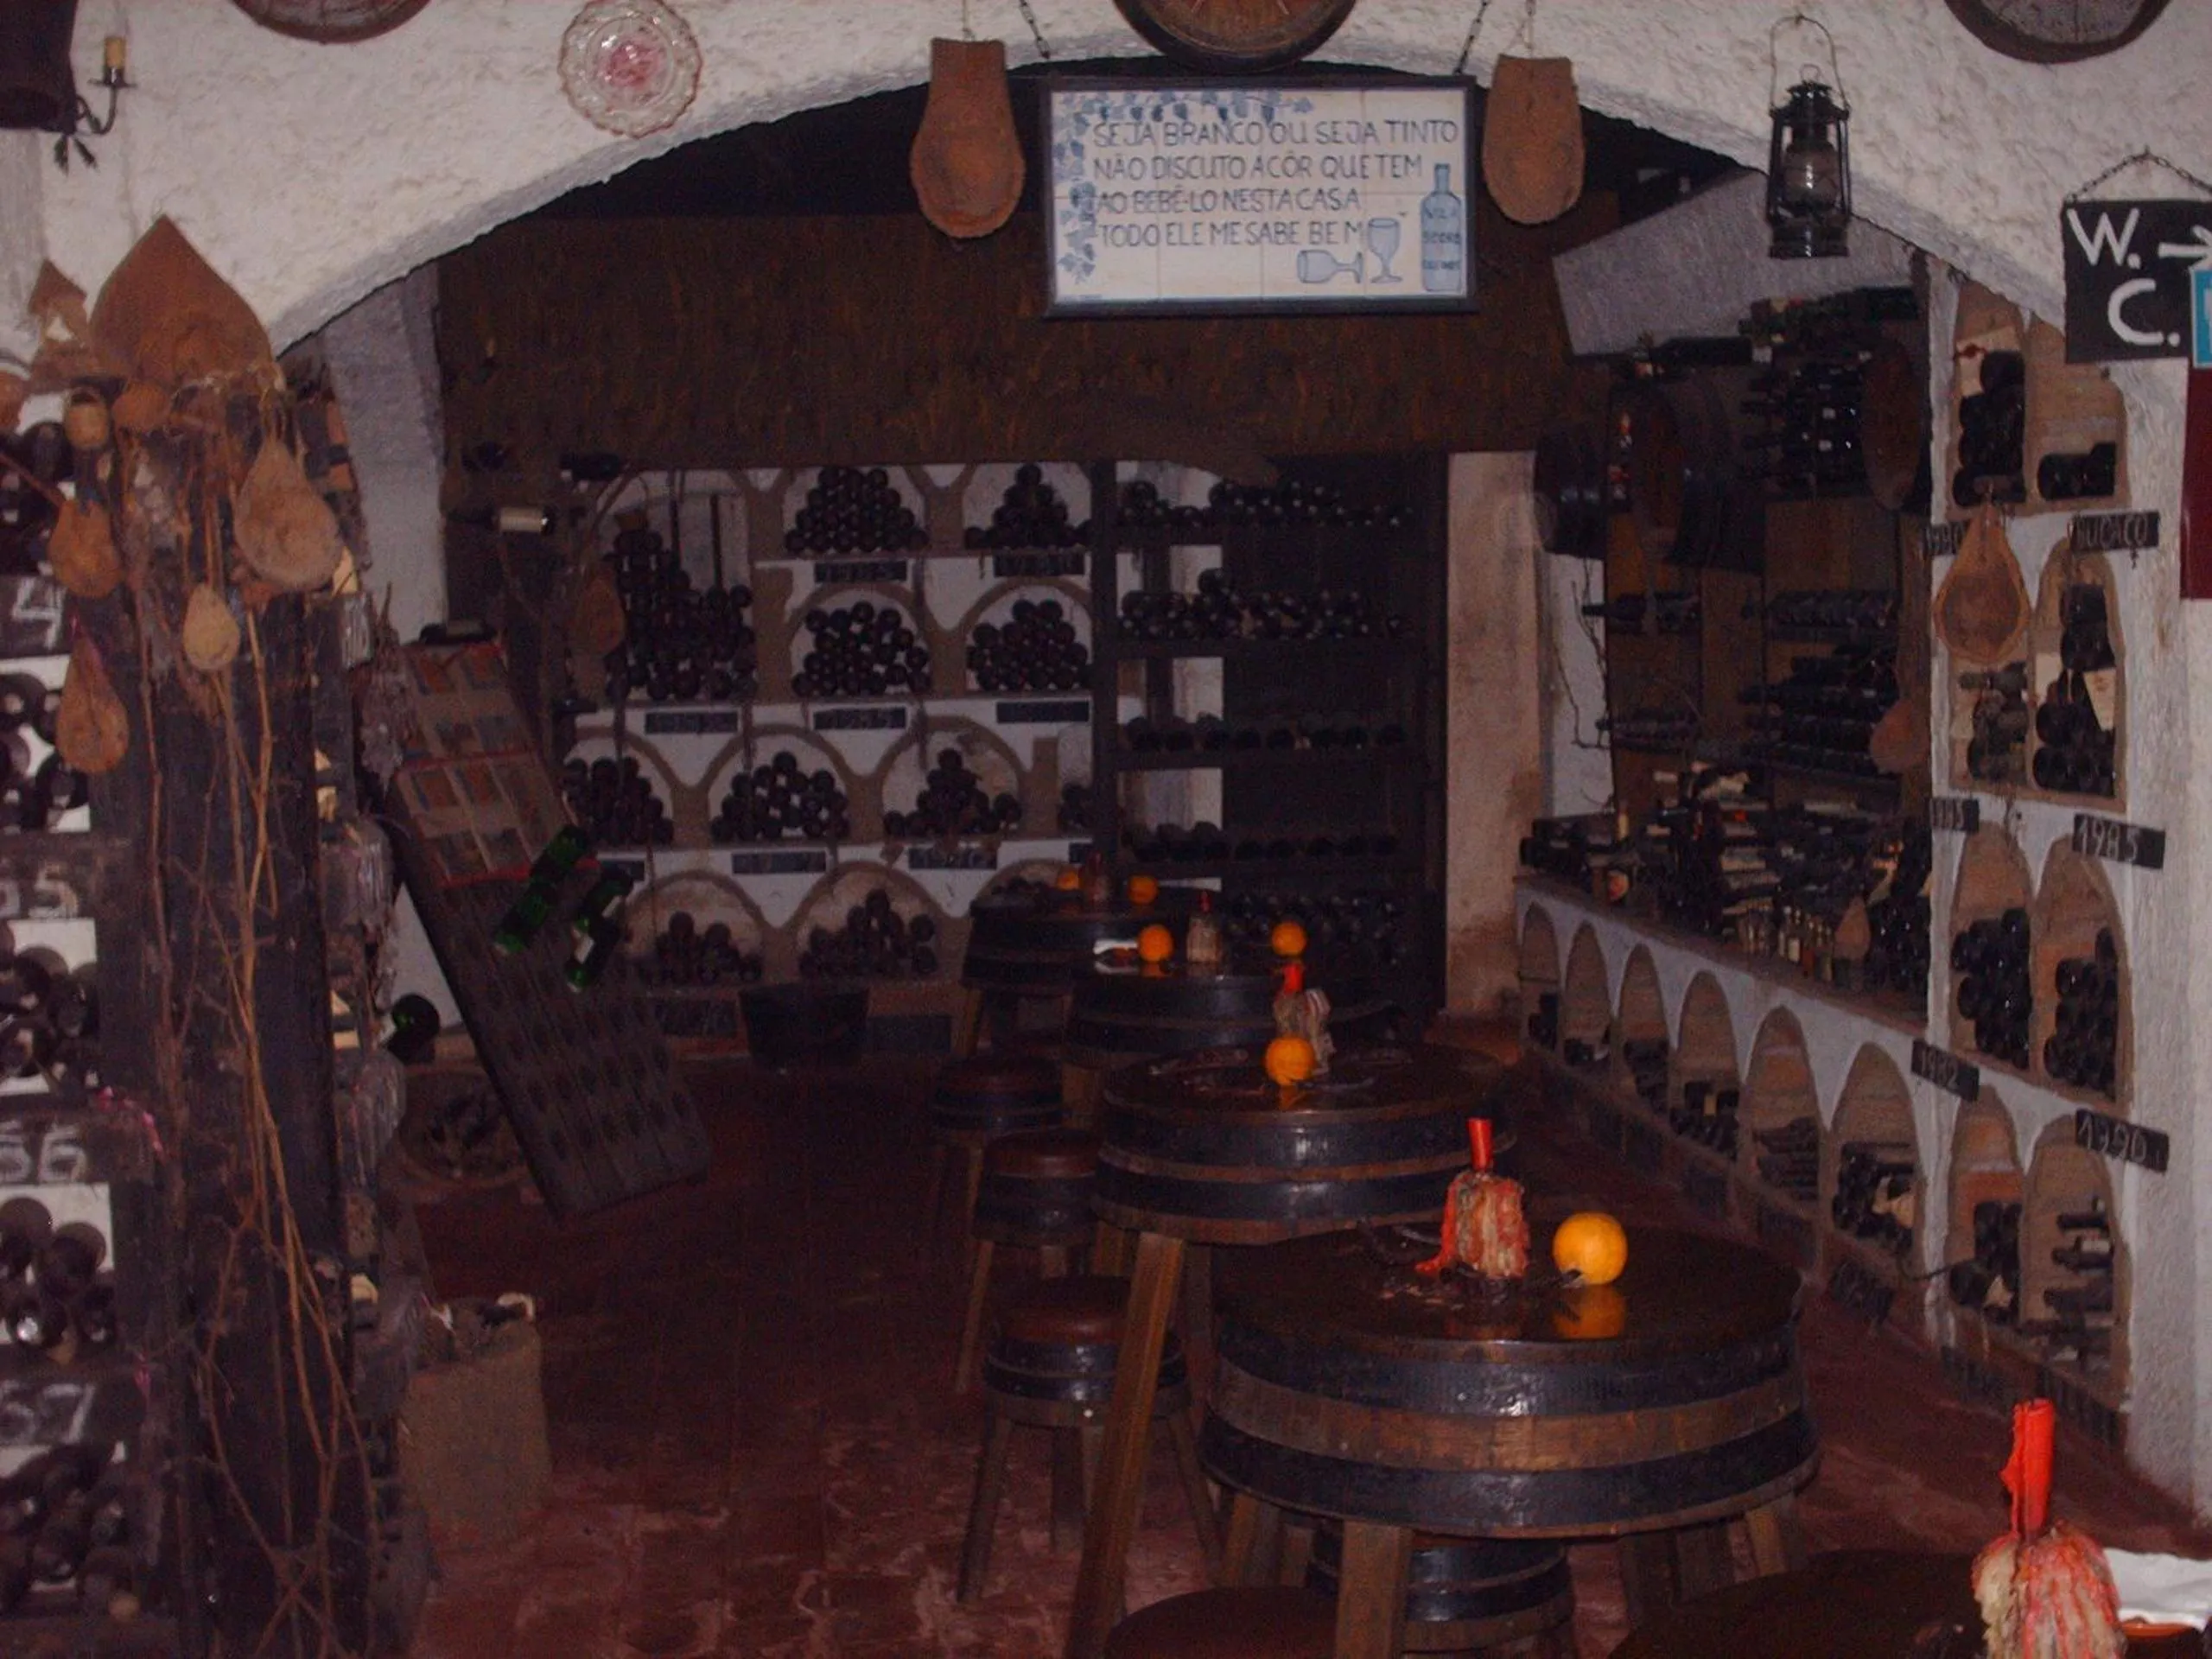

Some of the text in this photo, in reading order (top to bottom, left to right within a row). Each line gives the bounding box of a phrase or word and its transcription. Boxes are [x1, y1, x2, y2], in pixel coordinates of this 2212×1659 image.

[1093, 119, 1459, 148] SEJA BRANCO OU SEJA TINTO
[1093, 153, 1147, 181] NÃO
[1152, 155, 1247, 180] DISCUTO
[1098, 223, 1160, 248] TODO
[1166, 221, 1205, 247] ELE
[1308, 219, 1363, 245] BEM
